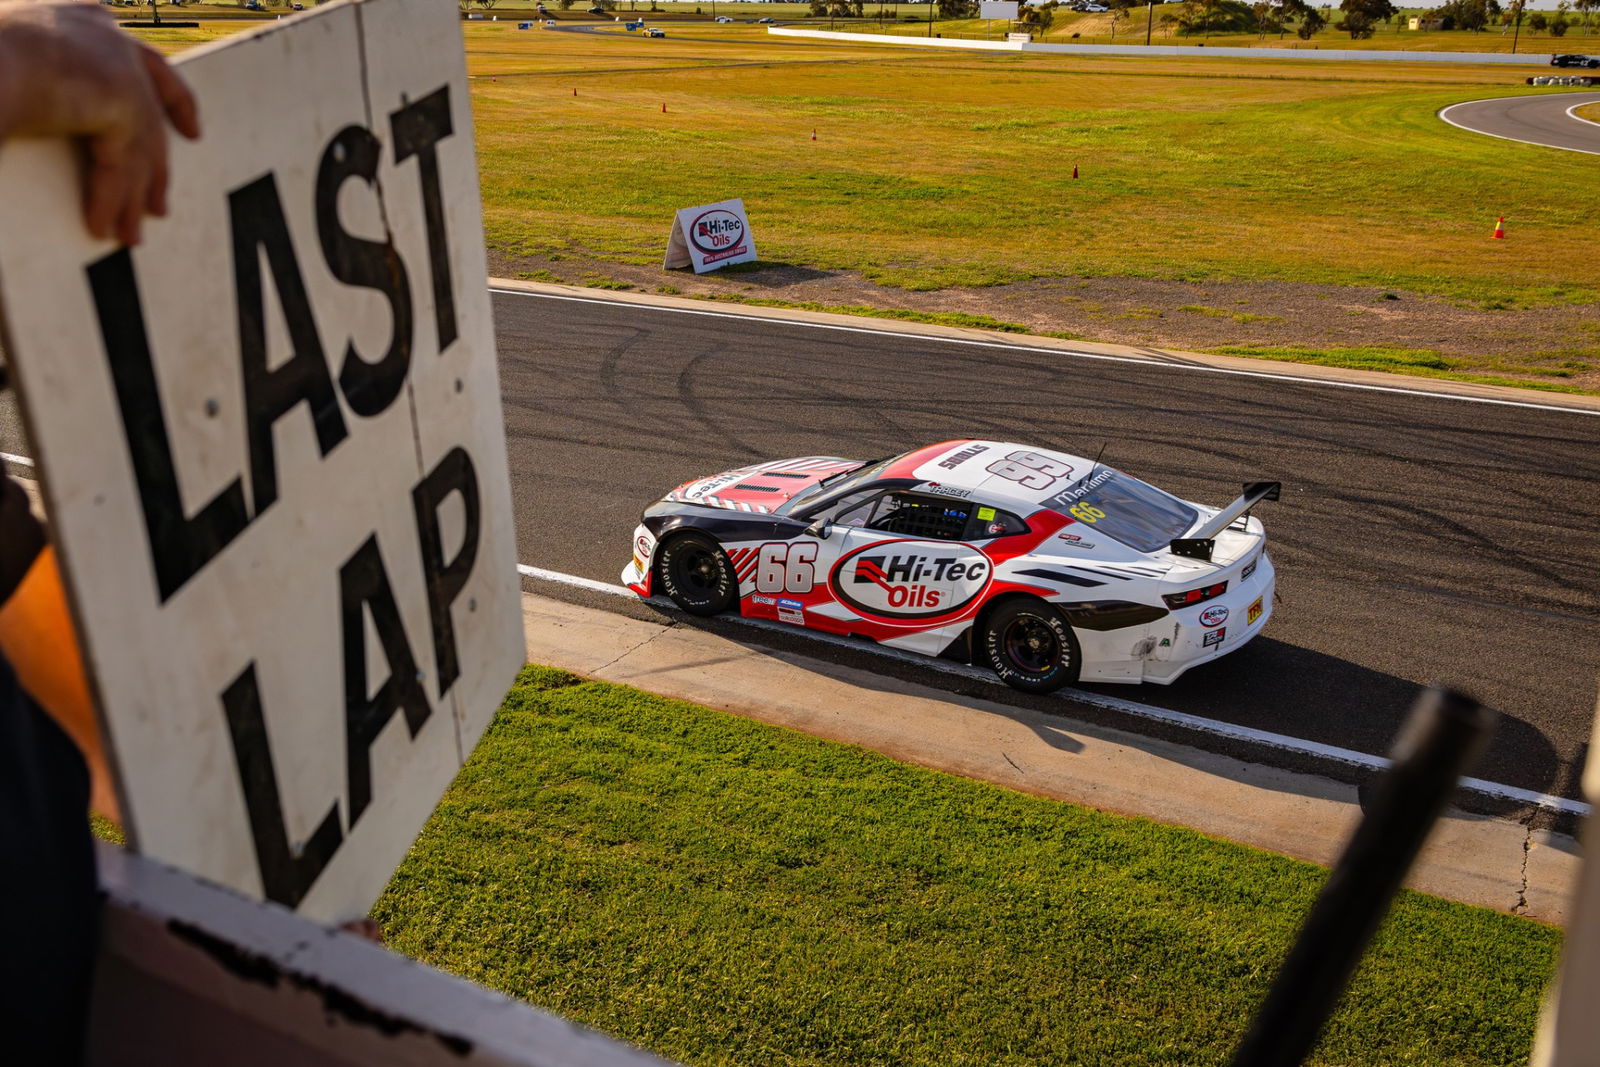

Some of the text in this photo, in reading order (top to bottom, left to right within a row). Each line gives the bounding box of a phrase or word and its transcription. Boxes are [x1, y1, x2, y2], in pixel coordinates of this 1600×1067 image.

[709, 220, 740, 234] Hi-Tec
[712, 234, 730, 247] Oils
[86, 84, 458, 605] LAST
[929, 485, 971, 498] TRACEY
[986, 450, 1074, 491] 66
[1069, 501, 1106, 523] 66
[660, 550, 678, 596] Hoosier
[712, 550, 730, 597] Hoosier
[756, 541, 818, 593] 66
[887, 555, 986, 583] Hi-Tec
[888, 585, 940, 608] Oils
[987, 630, 1011, 679] Hoosier
[1047, 617, 1071, 667] Hoosier
[221, 445, 481, 908] LAP
